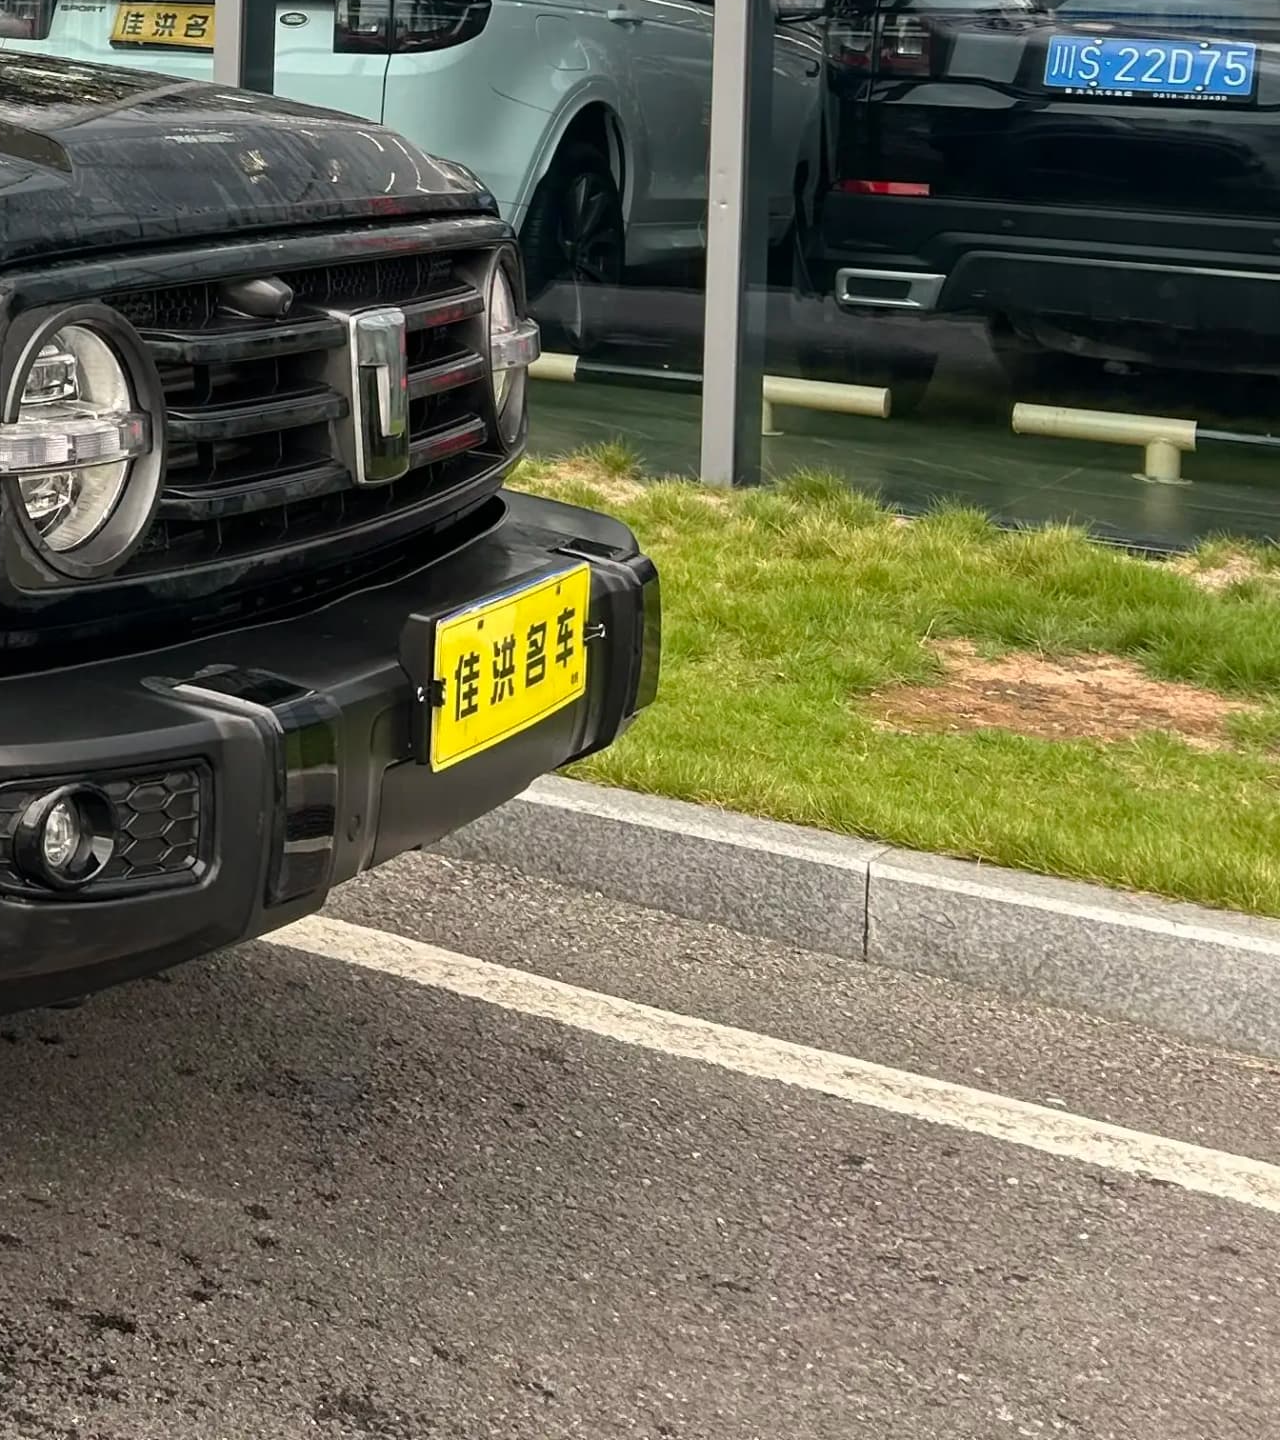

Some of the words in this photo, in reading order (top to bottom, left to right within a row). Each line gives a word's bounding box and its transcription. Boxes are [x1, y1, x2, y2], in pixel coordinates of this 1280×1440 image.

[60, 3, 107, 14] SPORT
[121, 11, 210, 39] 佳洪名
[454, 607, 576, 722] 佳洪名车
